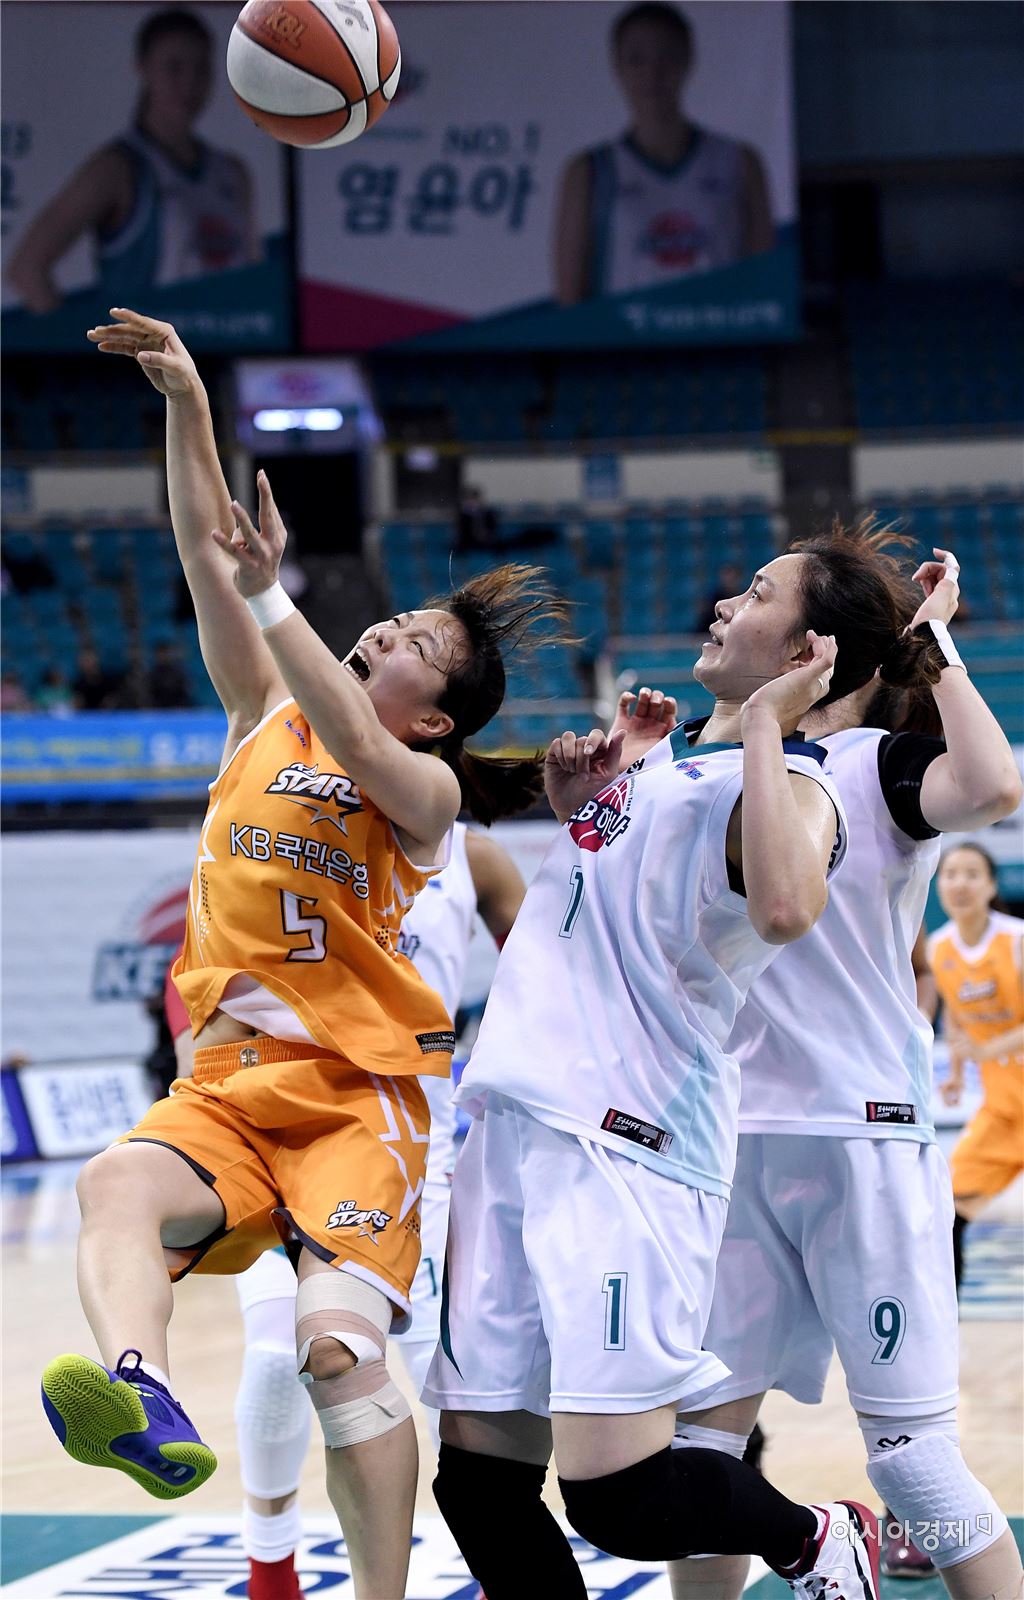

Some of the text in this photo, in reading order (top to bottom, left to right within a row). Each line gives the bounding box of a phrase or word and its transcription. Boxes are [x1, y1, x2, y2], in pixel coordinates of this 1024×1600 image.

[338, 161, 535, 235] 염윤아
[279, 888, 327, 963] 5
[559, 865, 585, 938] 1
[325, 1209, 393, 1229] STARS
[337, 1200, 356, 1212] KB
[602, 1272, 628, 1350] 1
[869, 1296, 906, 1365] 9
